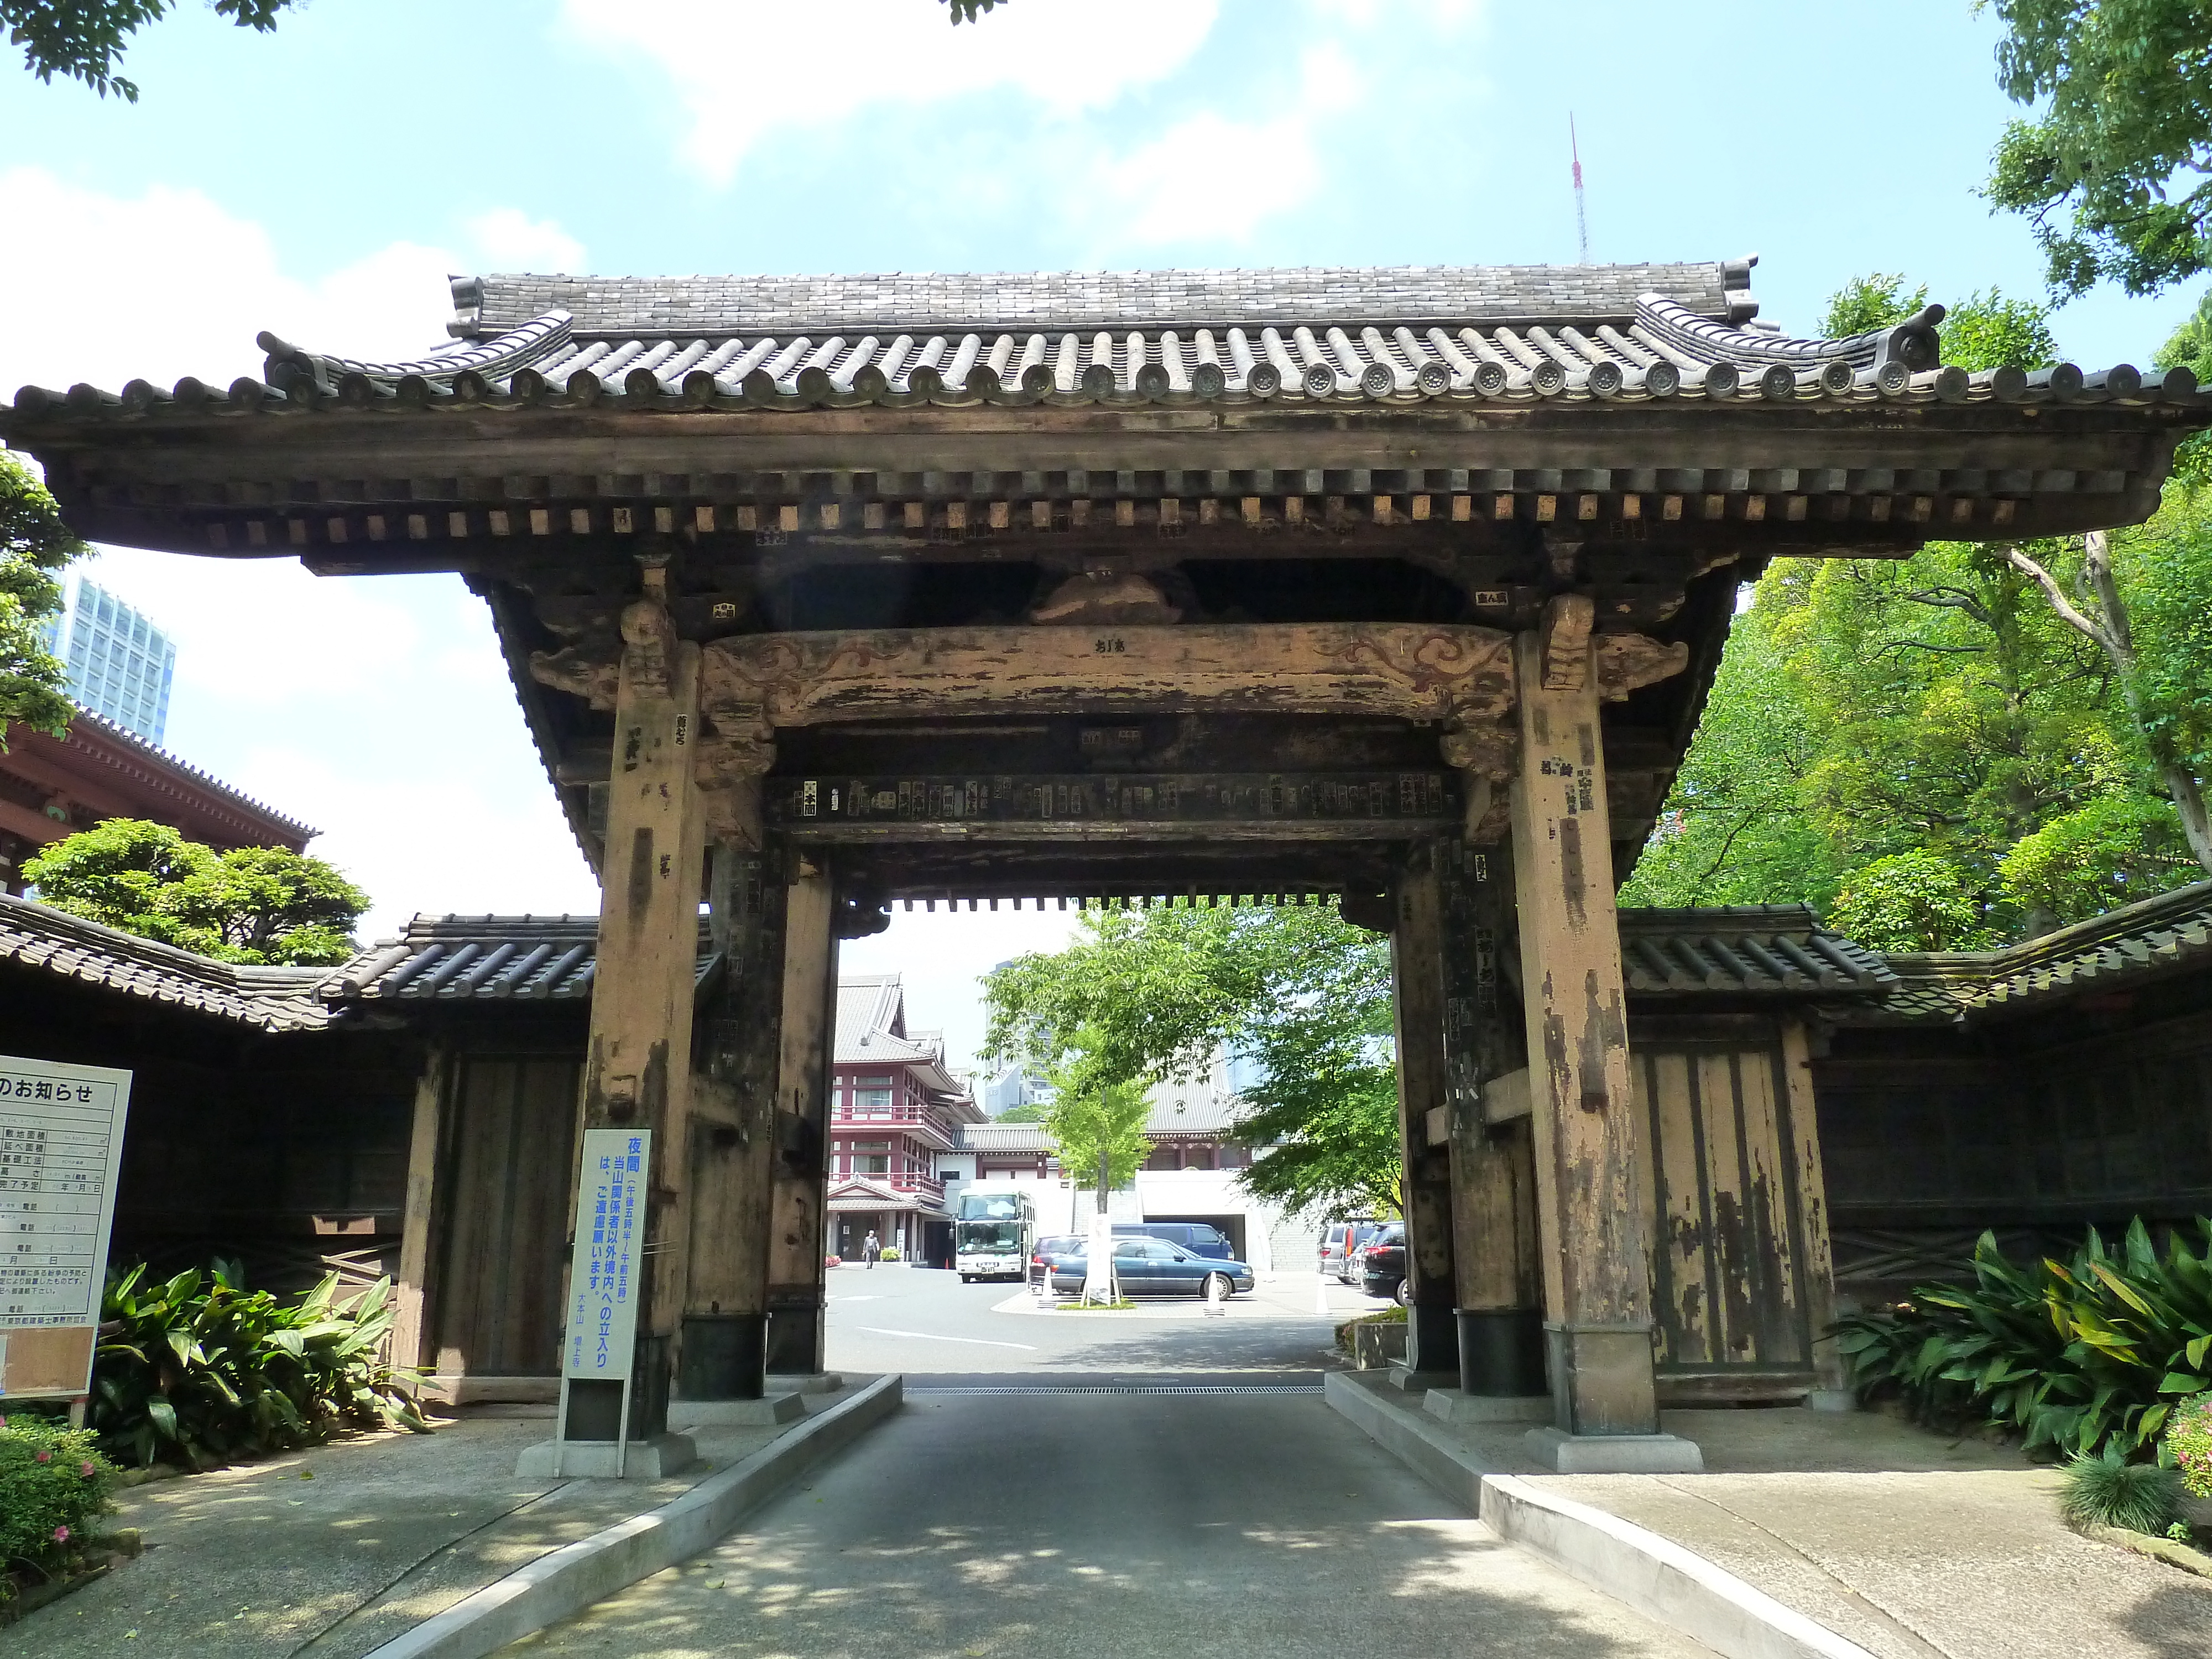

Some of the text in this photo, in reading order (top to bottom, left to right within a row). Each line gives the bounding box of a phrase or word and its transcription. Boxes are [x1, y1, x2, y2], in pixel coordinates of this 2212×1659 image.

[0, 1078, 92, 1103] のお知らせ
[4, 1141, 43, 1152] 延べ面積
[3, 1154, 42, 1165] 基礎工法
[597, 1156, 625, 1368] 当山関係者以外境内への立入り
